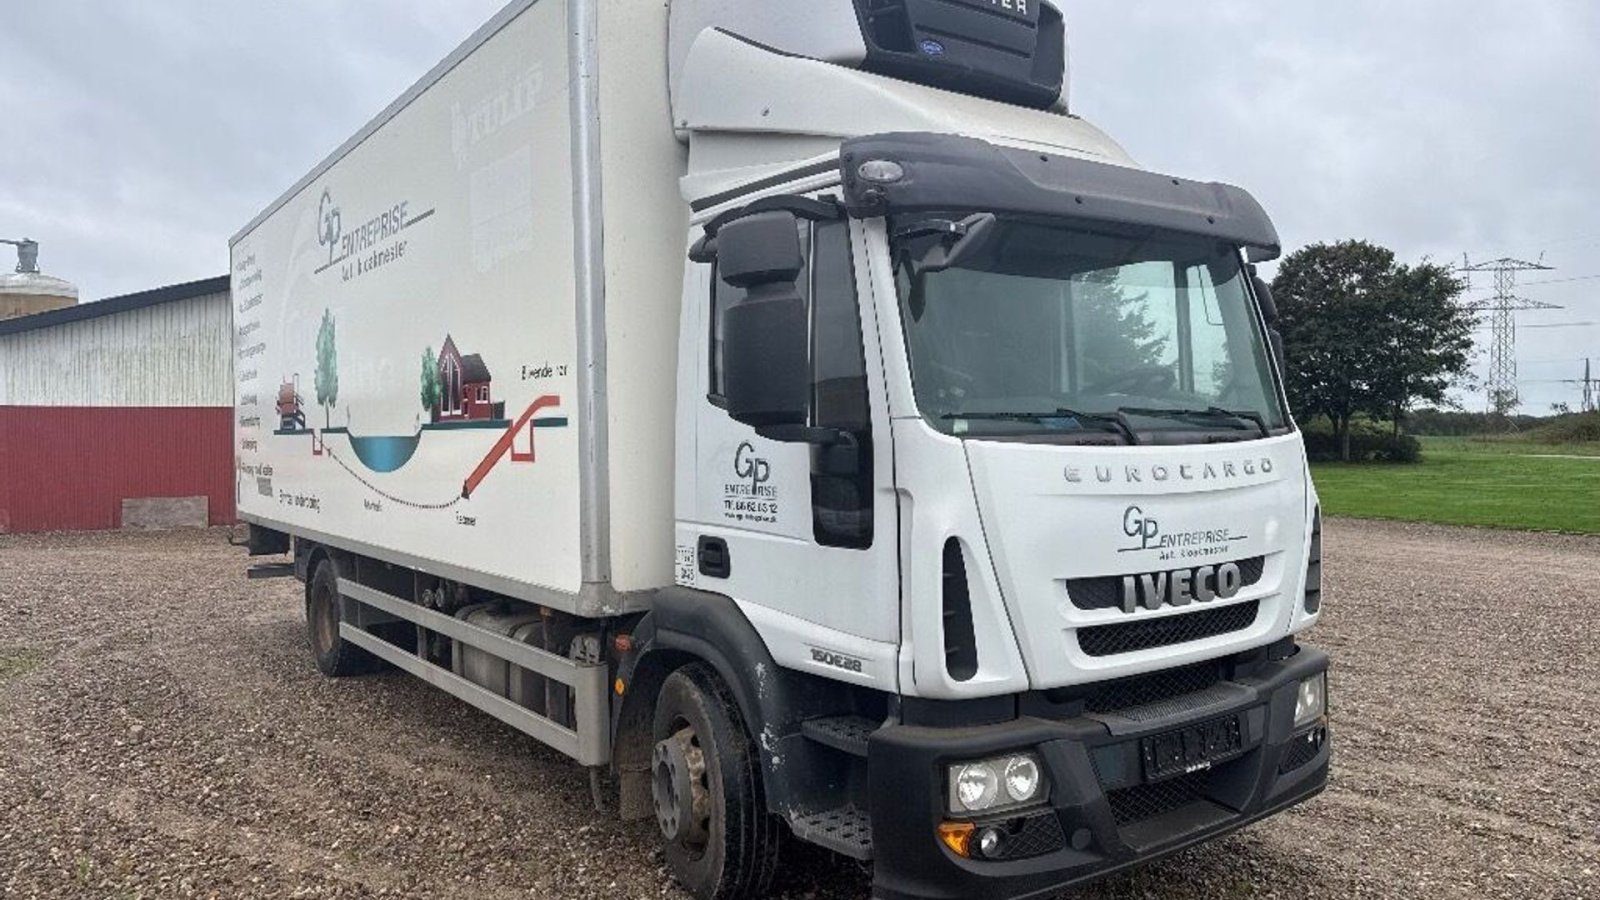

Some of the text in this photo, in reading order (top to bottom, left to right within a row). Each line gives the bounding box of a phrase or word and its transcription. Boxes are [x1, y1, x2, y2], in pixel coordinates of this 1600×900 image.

[341, 200, 409, 258] ENTREPRISE
[1063, 457, 1273, 482] EUROCARGO
[1159, 528, 1230, 548] ENTREPRISE
[1123, 562, 1242, 614] IVECO
[810, 648, 862, 673] 150E28
